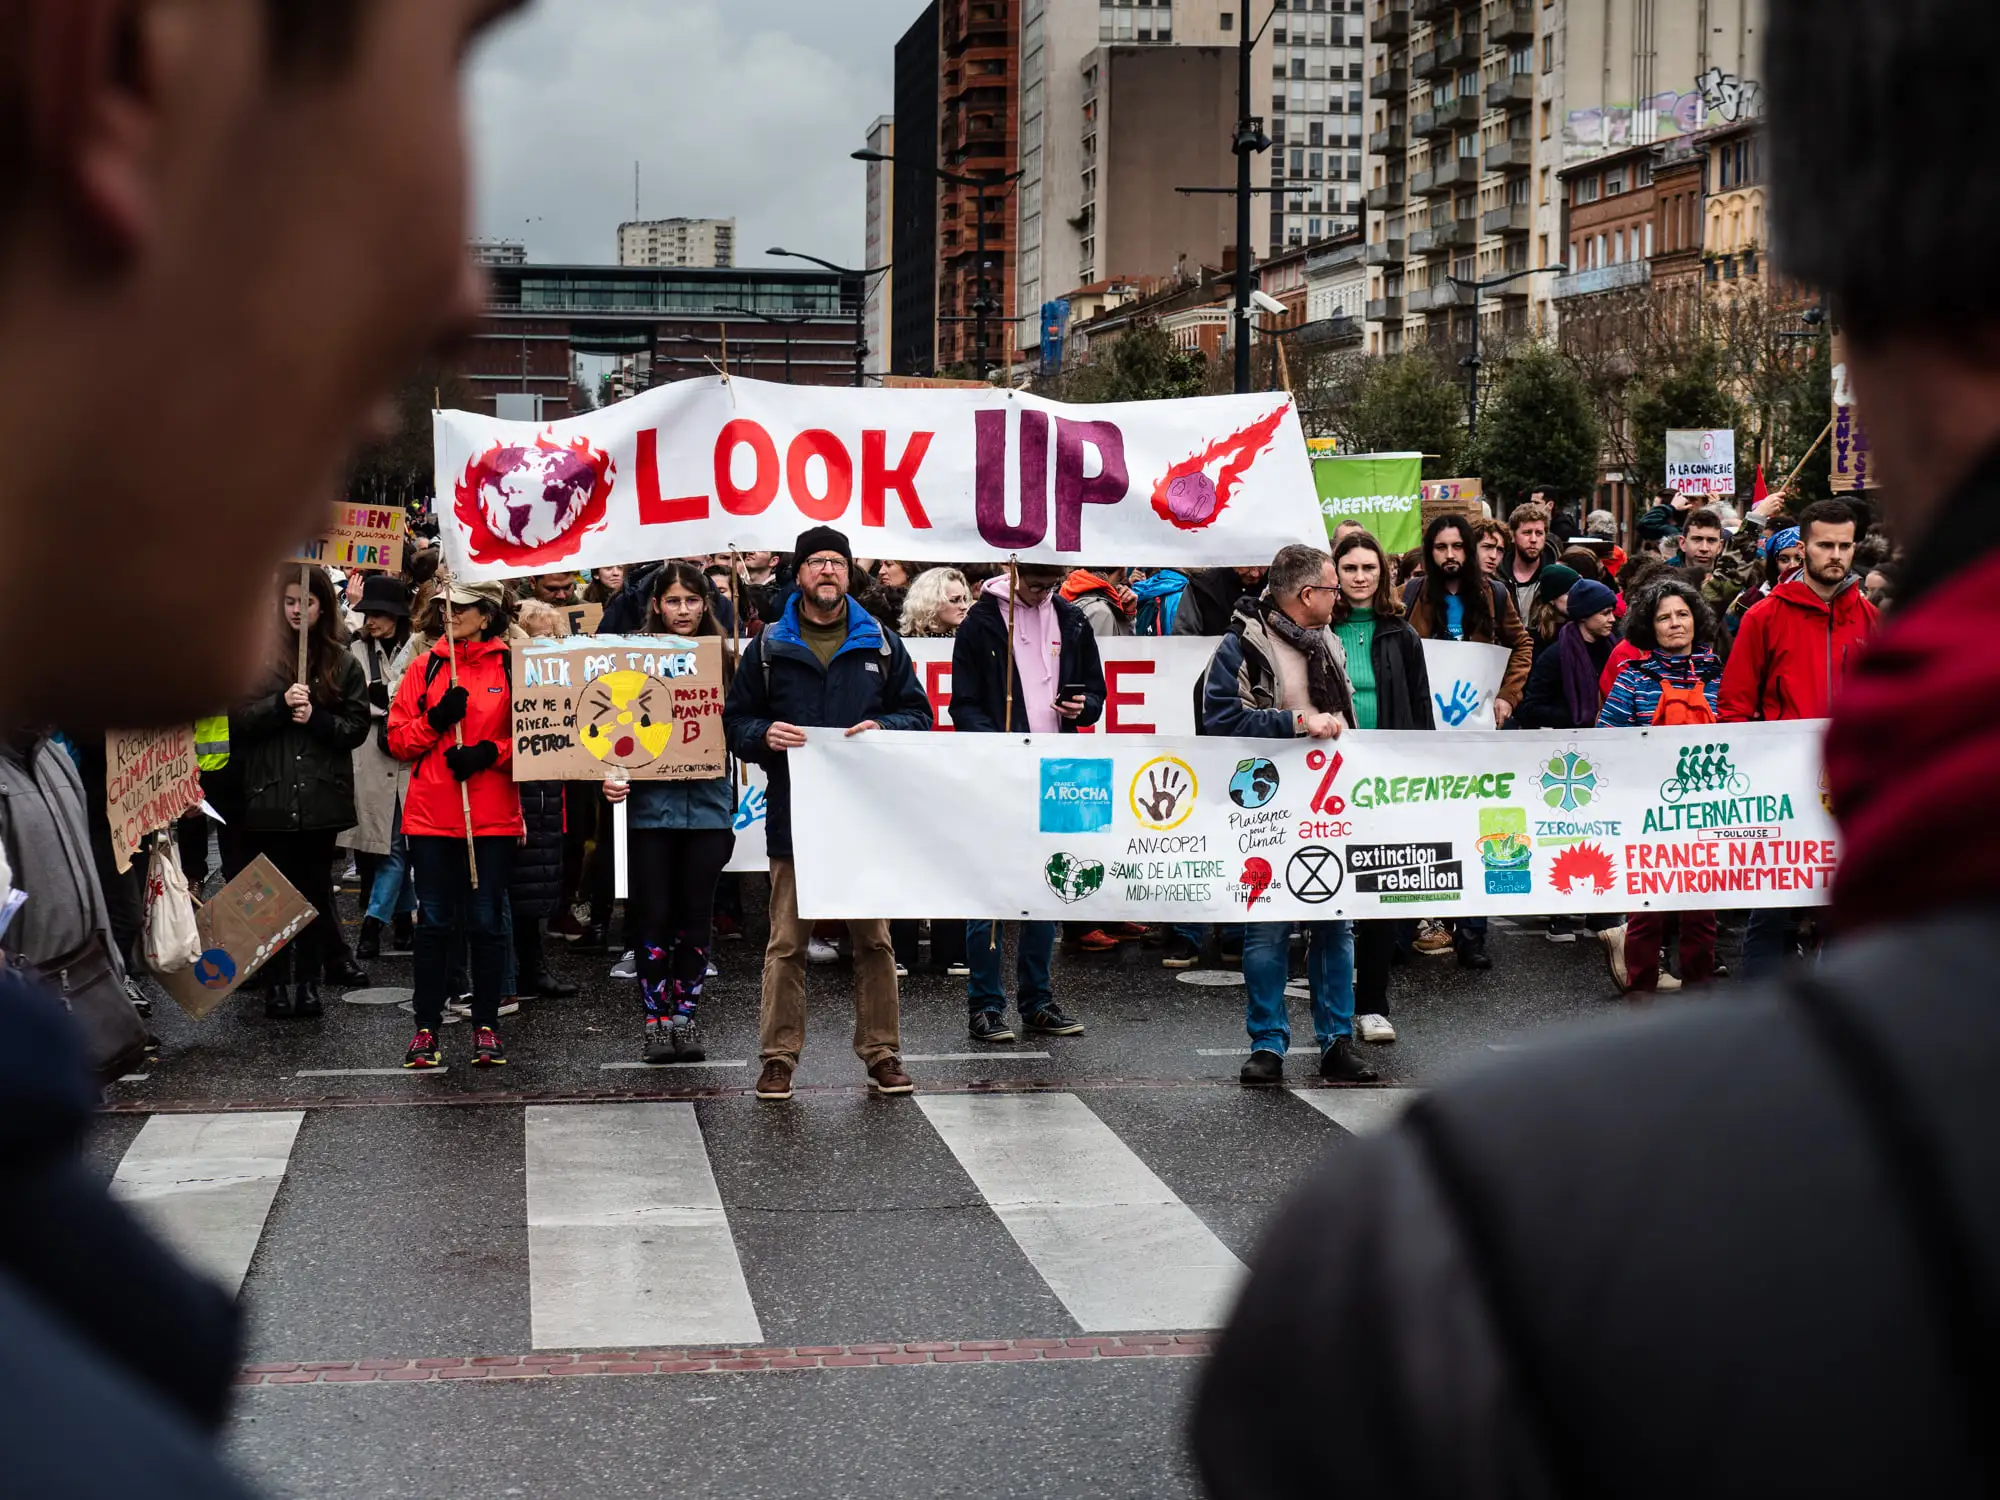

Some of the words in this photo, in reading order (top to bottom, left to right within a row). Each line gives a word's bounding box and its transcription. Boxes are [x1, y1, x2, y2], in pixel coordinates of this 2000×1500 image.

[1678, 464, 1689, 475] LA
[1691, 463, 1732, 474] CONNERIE
[635, 418, 935, 529] LOOK
[975, 409, 1129, 552] UP
[1669, 477, 1733, 493] CAPITALISTE
[525, 657, 572, 687] NIK
[584, 653, 617, 683] PAS
[674, 688, 697, 700] PAS
[514, 698, 537, 713] CRY
[542, 698, 557, 712] ME
[564, 697, 572, 710] A
[563, 714, 577, 728] OF
[682, 721, 700, 744] B
[518, 733, 575, 756] PETROL
[122, 785, 144, 815] NOUS
[165, 753, 188, 785] PLUS
[1044, 785, 1056, 800] A
[1058, 786, 1108, 801] ROCHA
[1350, 772, 1515, 809] GREENPEACE
[1228, 809, 1292, 830] Plaisance
[1642, 793, 1794, 834] ALTERNATIBA
[1270, 823, 1279, 832] le
[1298, 821, 1352, 839] attac
[1534, 820, 1622, 836] ZEROWASTE
[1713, 829, 1768, 839] TOULOUSE
[1127, 835, 1206, 854] ANV-COP21
[1238, 827, 1287, 854] Climat
[1351, 845, 1436, 868] extinction
[1624, 842, 1719, 870] FRANCE
[1729, 840, 1837, 866] NATURE
[1109, 860, 1121, 877] LES
[1116, 862, 1143, 879] AMIS
[1148, 862, 1164, 879] DE
[1168, 861, 1182, 878] LA
[1181, 860, 1226, 878] TERRE
[1377, 862, 1458, 890] rebellion
[1226, 882, 1240, 892] des
[1241, 880, 1269, 891] droits
[1271, 879, 1281, 889] de
[1626, 866, 1836, 895] ENVIRONNEMENT
[1234, 891, 1272, 903] l'Homme
